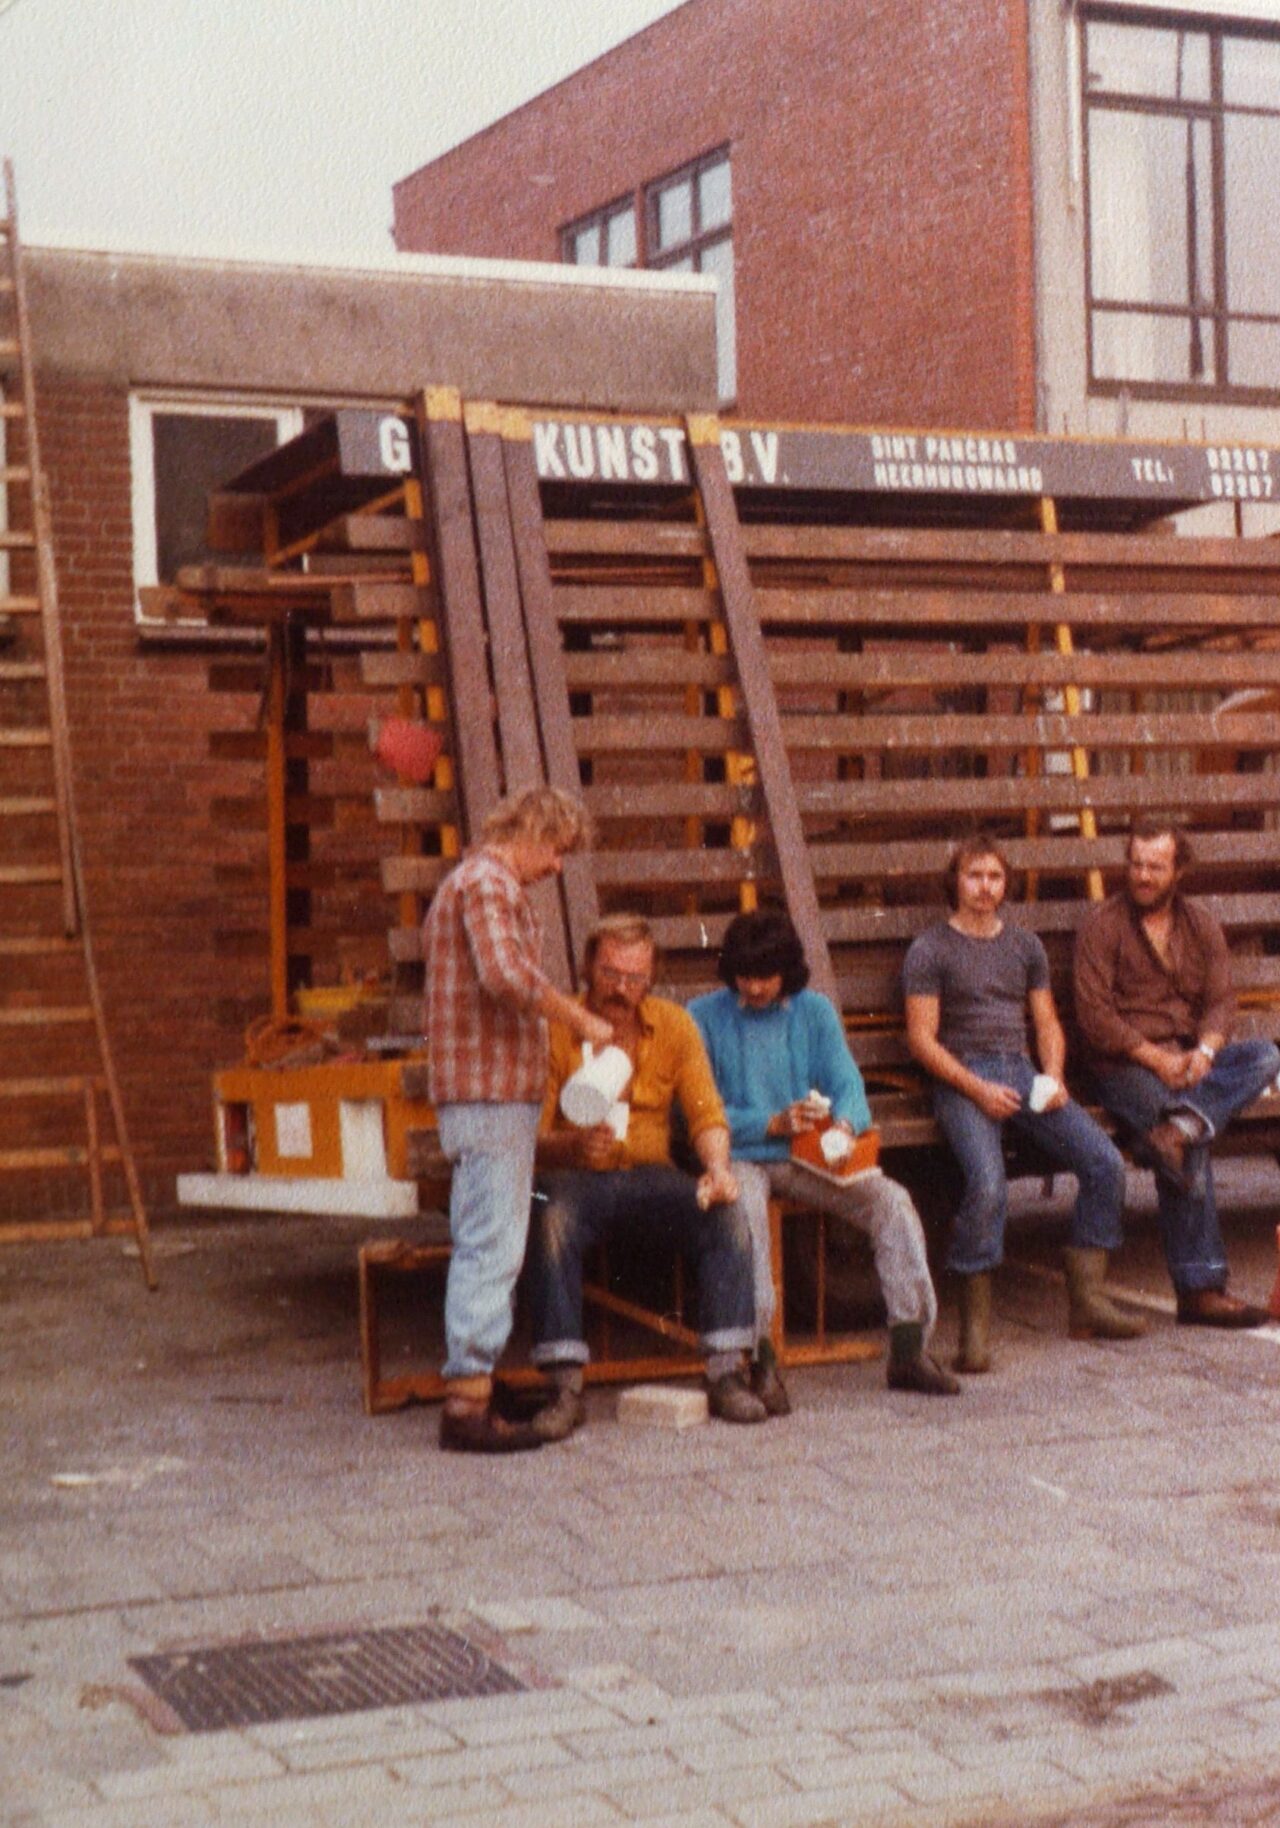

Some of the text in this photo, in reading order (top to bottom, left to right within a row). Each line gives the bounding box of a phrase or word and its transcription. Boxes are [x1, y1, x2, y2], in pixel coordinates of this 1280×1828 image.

[533, 423, 686, 481] KUNST
[872, 434, 1017, 464] SINT PANCRAS
[874, 463, 1043, 492] HEERHUGOWAARD
